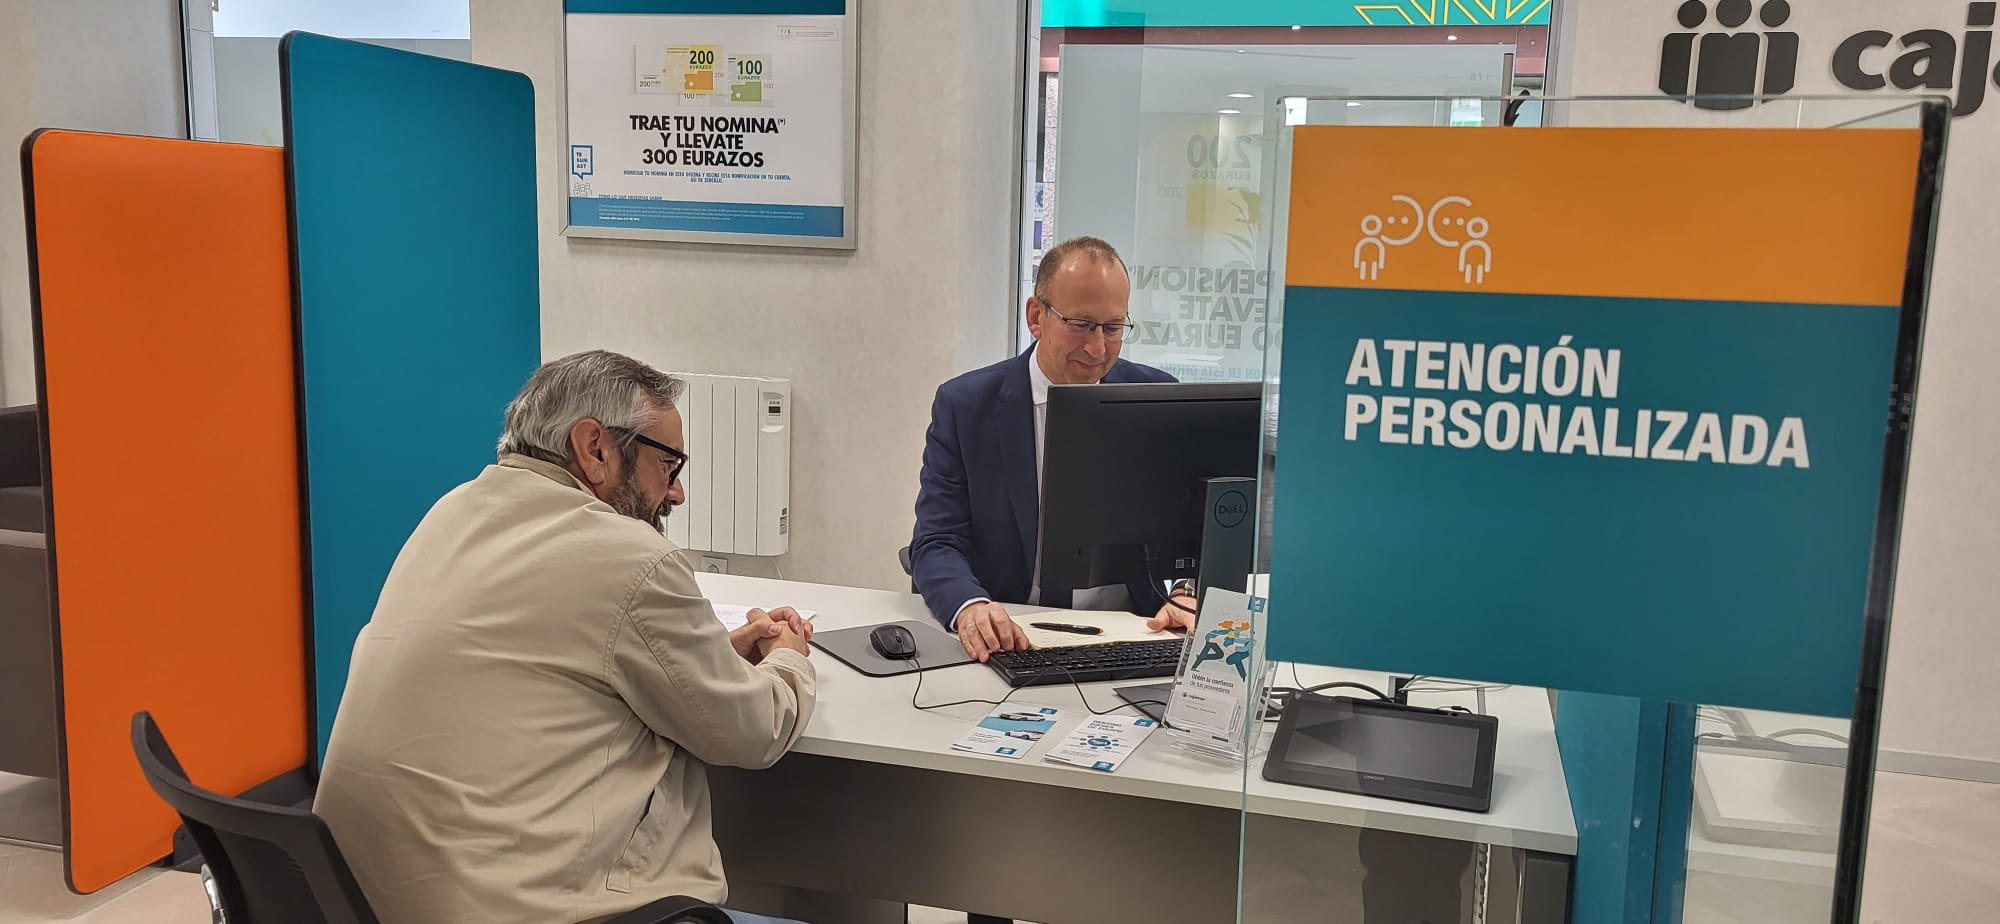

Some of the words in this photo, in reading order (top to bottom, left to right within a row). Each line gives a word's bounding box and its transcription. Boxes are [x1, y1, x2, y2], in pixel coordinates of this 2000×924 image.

[690, 50, 714, 65] 200
[737, 60, 763, 75] 100
[629, 114, 671, 131] TRAE
[674, 115, 695, 132] TU
[660, 132, 671, 148] Y
[676, 132, 744, 150] LLEVATE
[642, 148, 678, 165] 300
[682, 150, 765, 168] EURAZOS
[1344, 335, 1622, 399] ATENCIÓN
[1343, 393, 1811, 469] PERSONALIZADA
